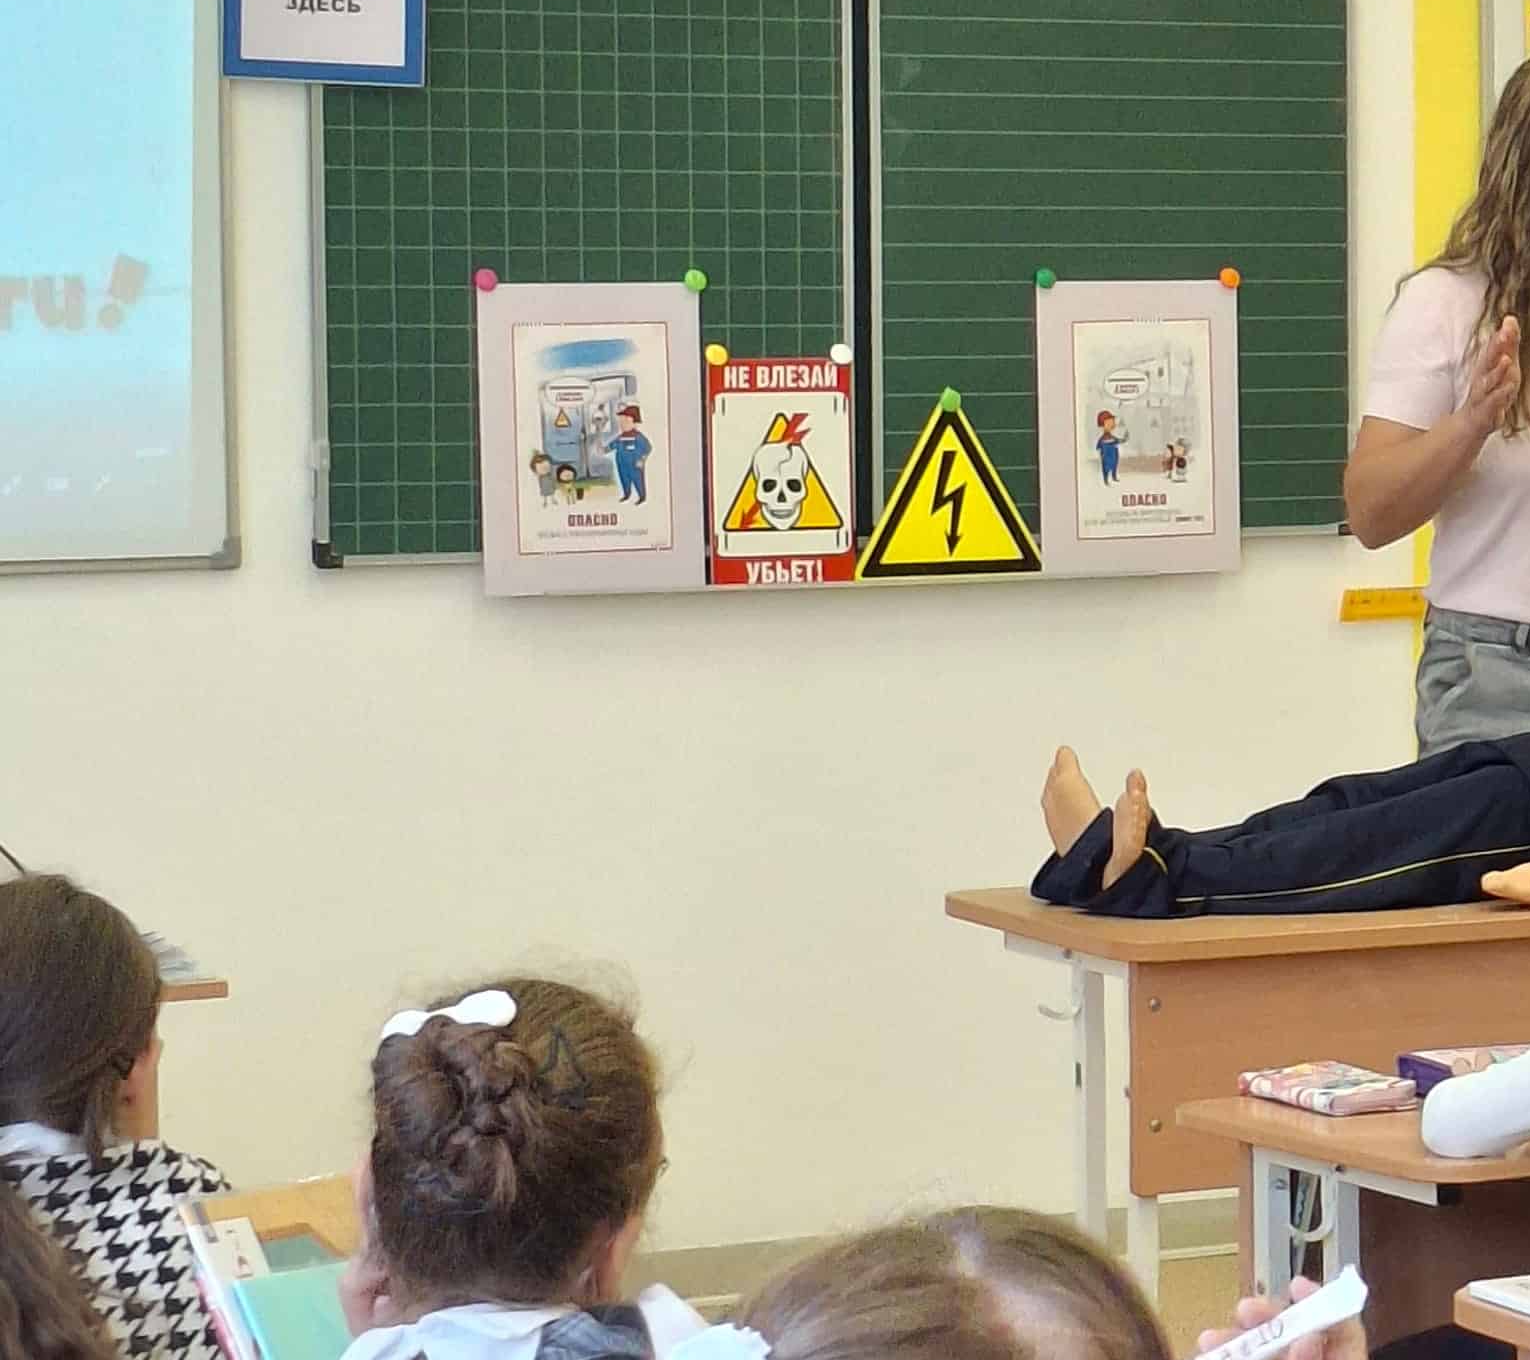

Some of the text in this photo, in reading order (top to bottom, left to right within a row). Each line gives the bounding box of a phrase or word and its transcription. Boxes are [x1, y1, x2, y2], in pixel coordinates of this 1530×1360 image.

[723, 361, 839, 390] НЕ ВЛЕЗАЙ
[568, 513, 618, 527] ОПАСНО
[746, 561, 824, 585] УБЬЕТ!
